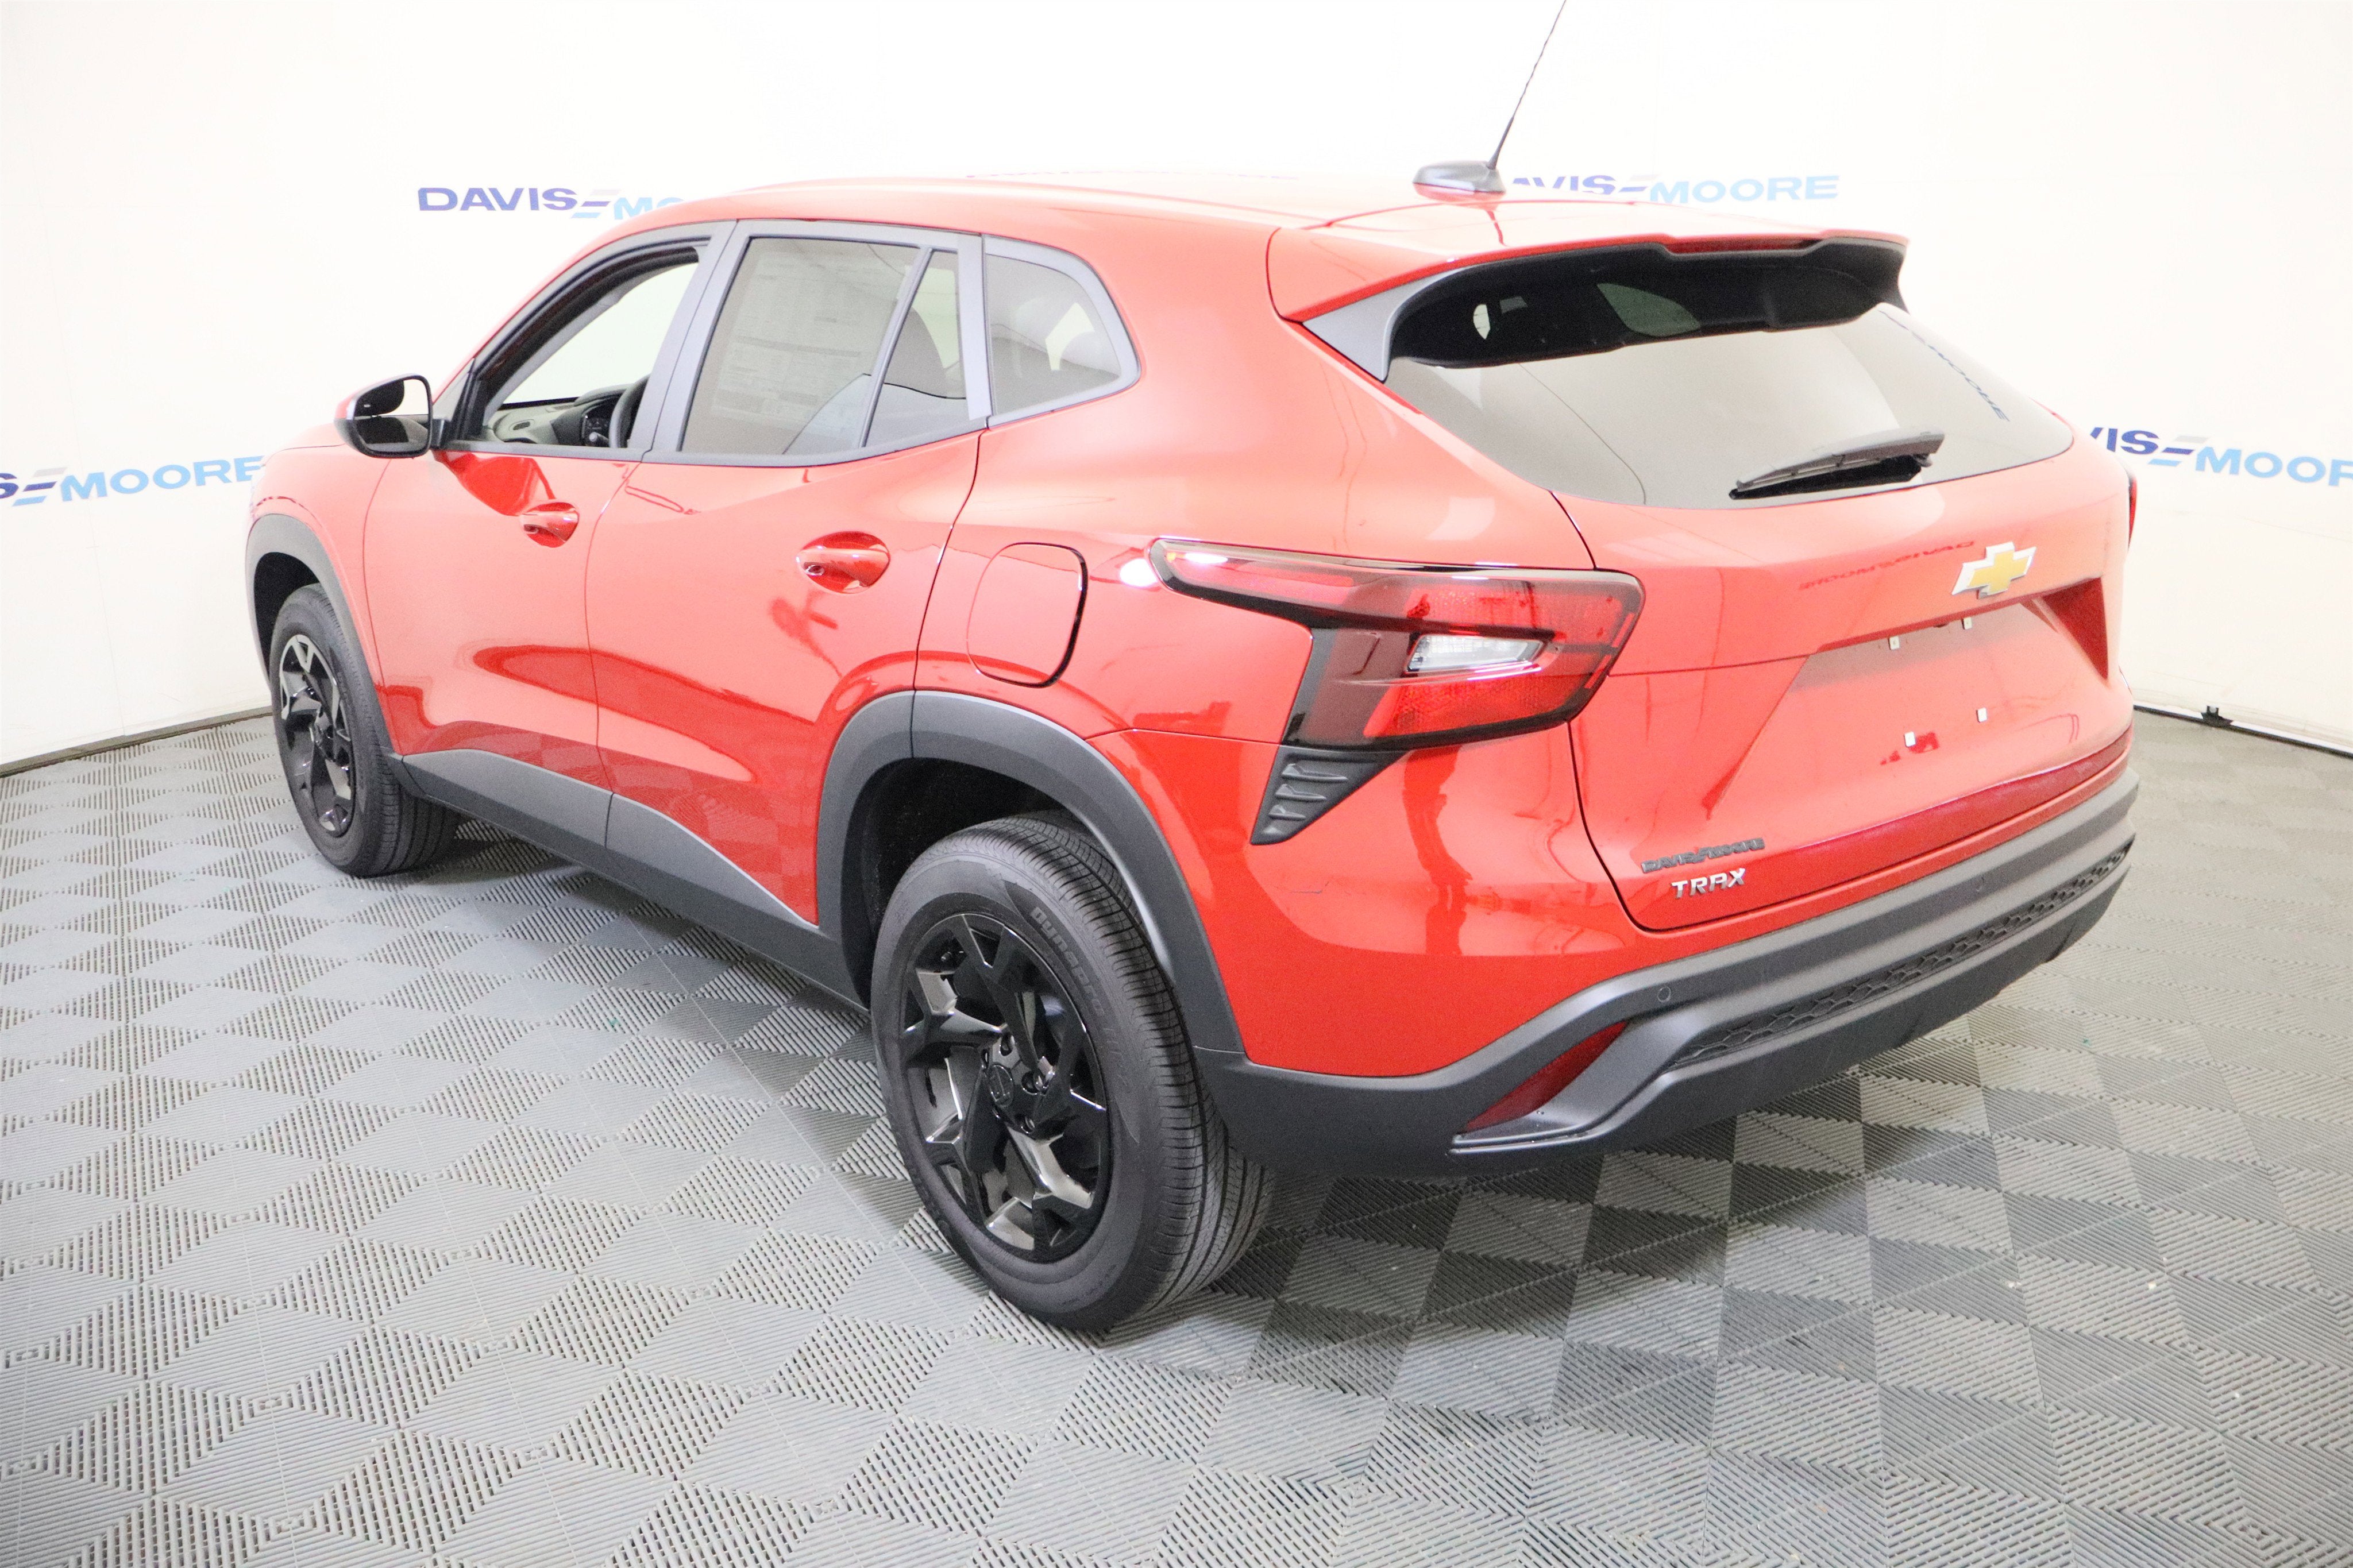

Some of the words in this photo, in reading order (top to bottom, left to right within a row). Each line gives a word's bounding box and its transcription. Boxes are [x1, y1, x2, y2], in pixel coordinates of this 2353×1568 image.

[418, 187, 577, 211] DAVIS
[1649, 175, 1838, 204] MOORE
[60, 455, 264, 502] MOORE
[1671, 867, 1746, 899] TRAX
